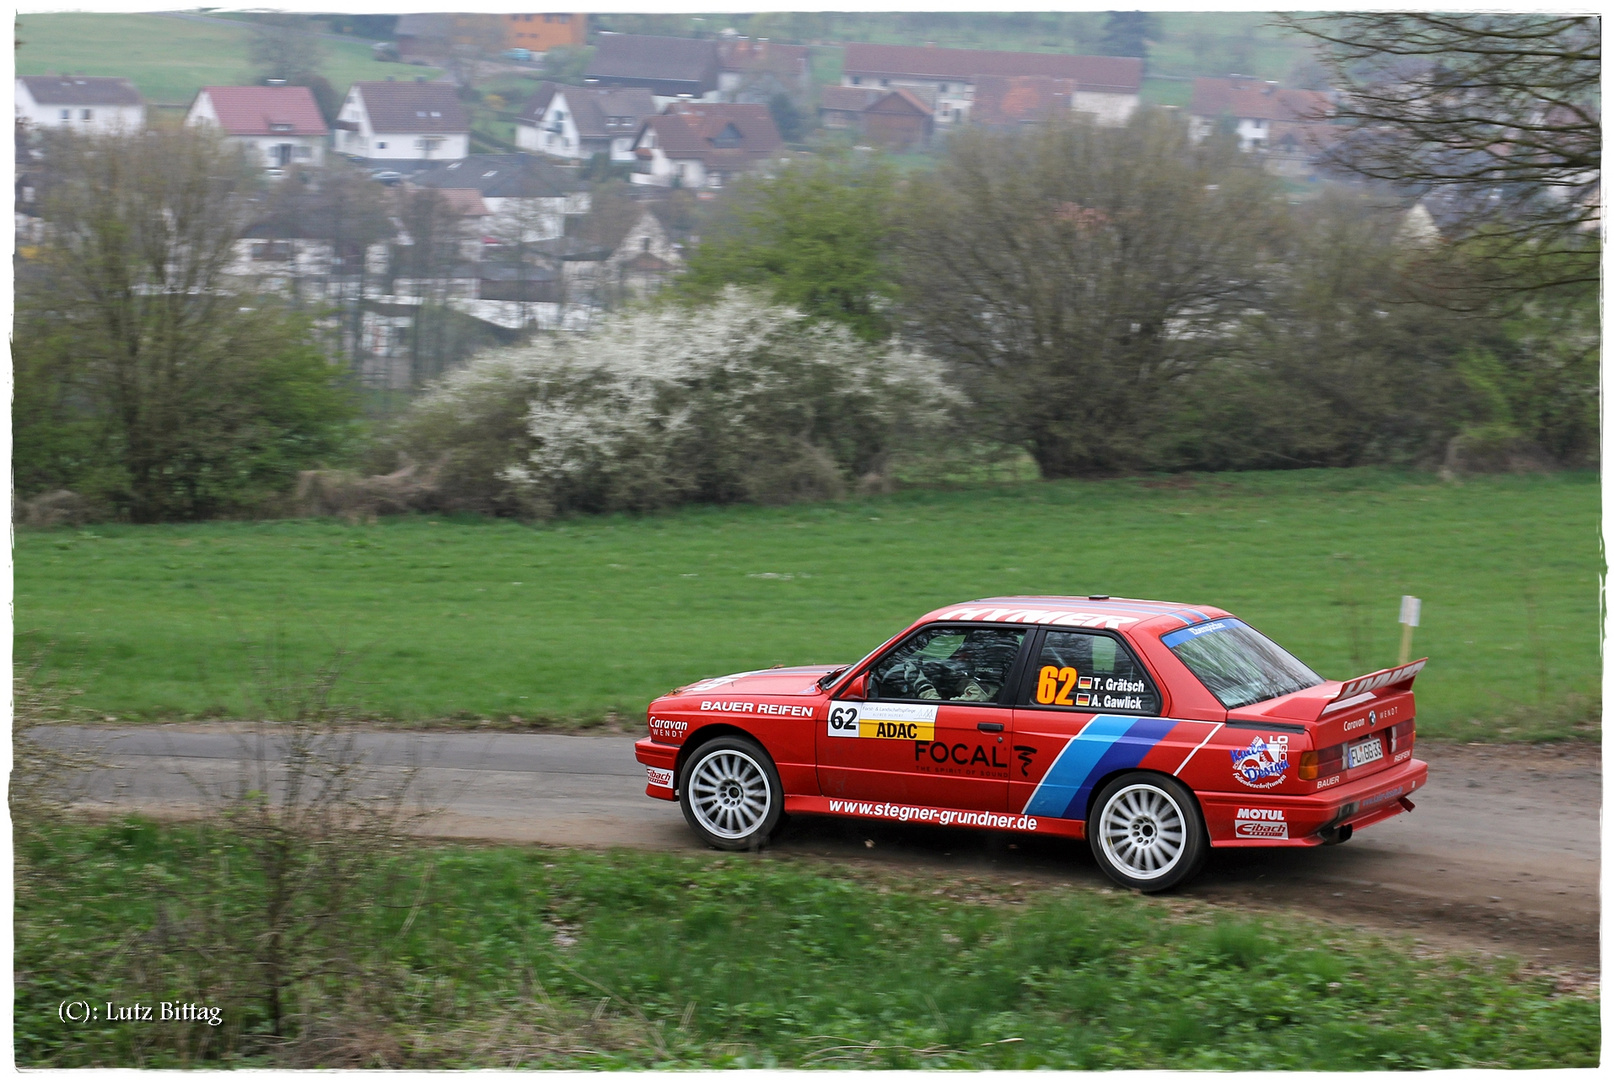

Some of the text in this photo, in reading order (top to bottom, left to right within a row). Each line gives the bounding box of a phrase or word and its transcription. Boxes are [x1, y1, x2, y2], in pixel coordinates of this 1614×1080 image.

[937, 607, 1140, 629] HYMER
[1036, 665, 1078, 706] 62
[1094, 677, 1145, 693] T. Grätsch
[700, 701, 814, 717] BAUER REIFEN
[1091, 694, 1142, 710] A. Gawlick
[830, 706, 858, 731] 62
[1379, 706, 1398, 719] WENDT
[649, 716, 688, 731] Caravan
[876, 722, 918, 739] ADAC
[1343, 717, 1365, 732] Caravan
[652, 728, 684, 738] WENDT
[915, 740, 1008, 768] FOCAL
[934, 766, 961, 774] SPIRIT
[980, 770, 1009, 778] SOUND
[1243, 759, 1290, 782] Design
[1316, 775, 1340, 789] BAUER
[829, 799, 1038, 831] www.stegner-grundner.de
[1236, 808, 1285, 821] MOTUL
[1236, 822, 1287, 838] Eibach
